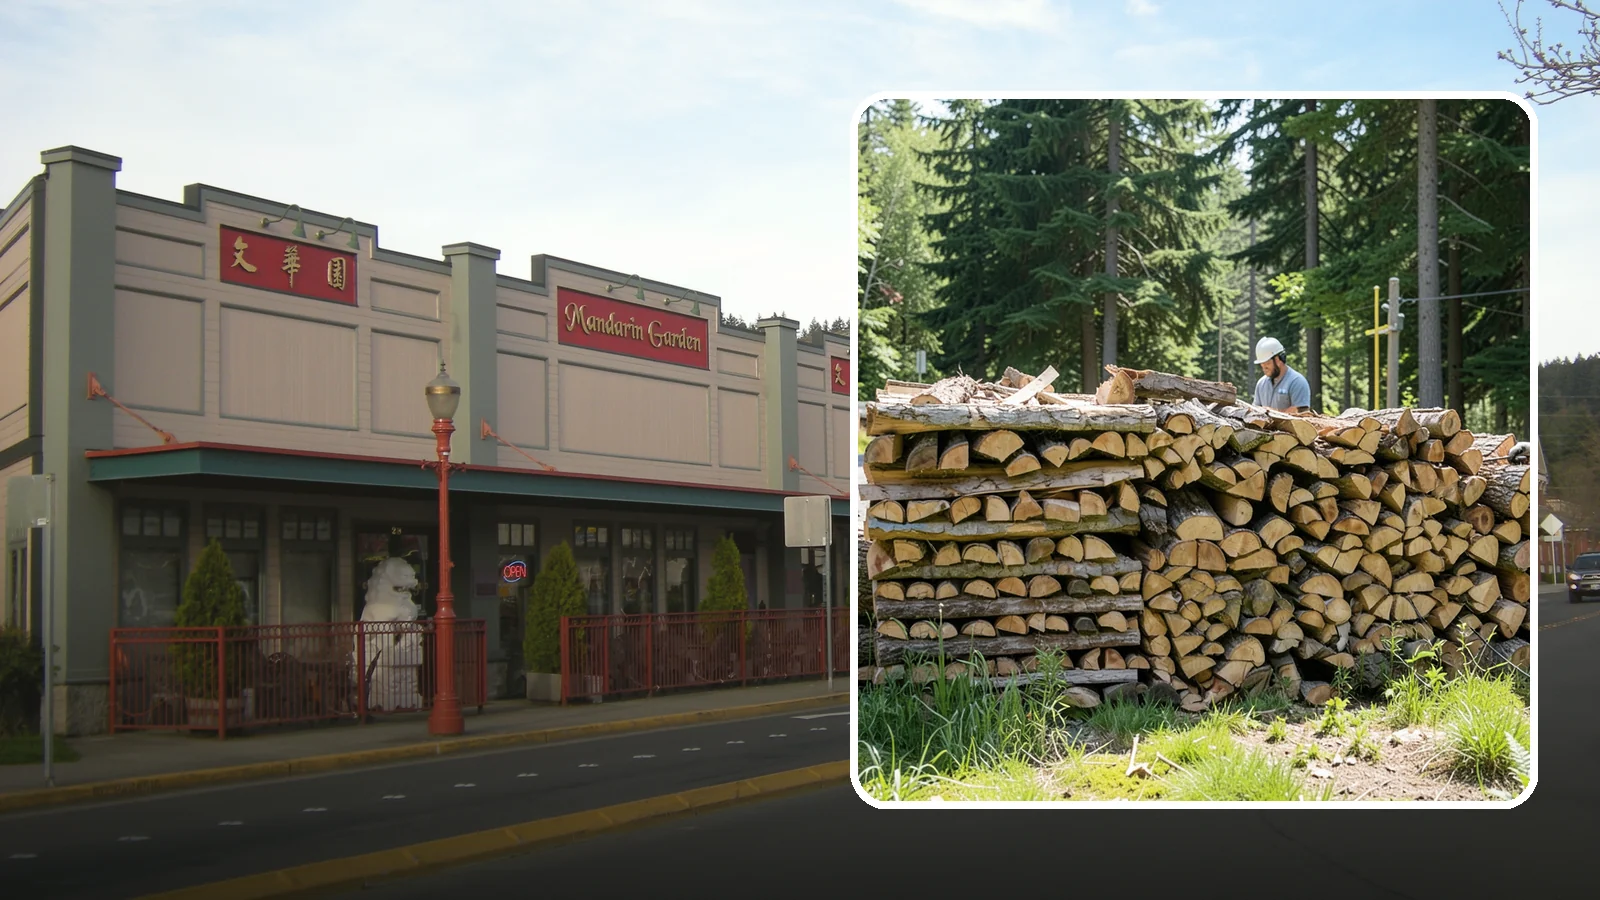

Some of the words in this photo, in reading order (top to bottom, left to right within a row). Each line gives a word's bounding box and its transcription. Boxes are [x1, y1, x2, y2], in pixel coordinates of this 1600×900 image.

[230, 236, 346, 291] 文華園
[564, 302, 643, 341] Mandarin
[648, 320, 701, 352] Garden
[503, 565, 527, 578] OPEN
